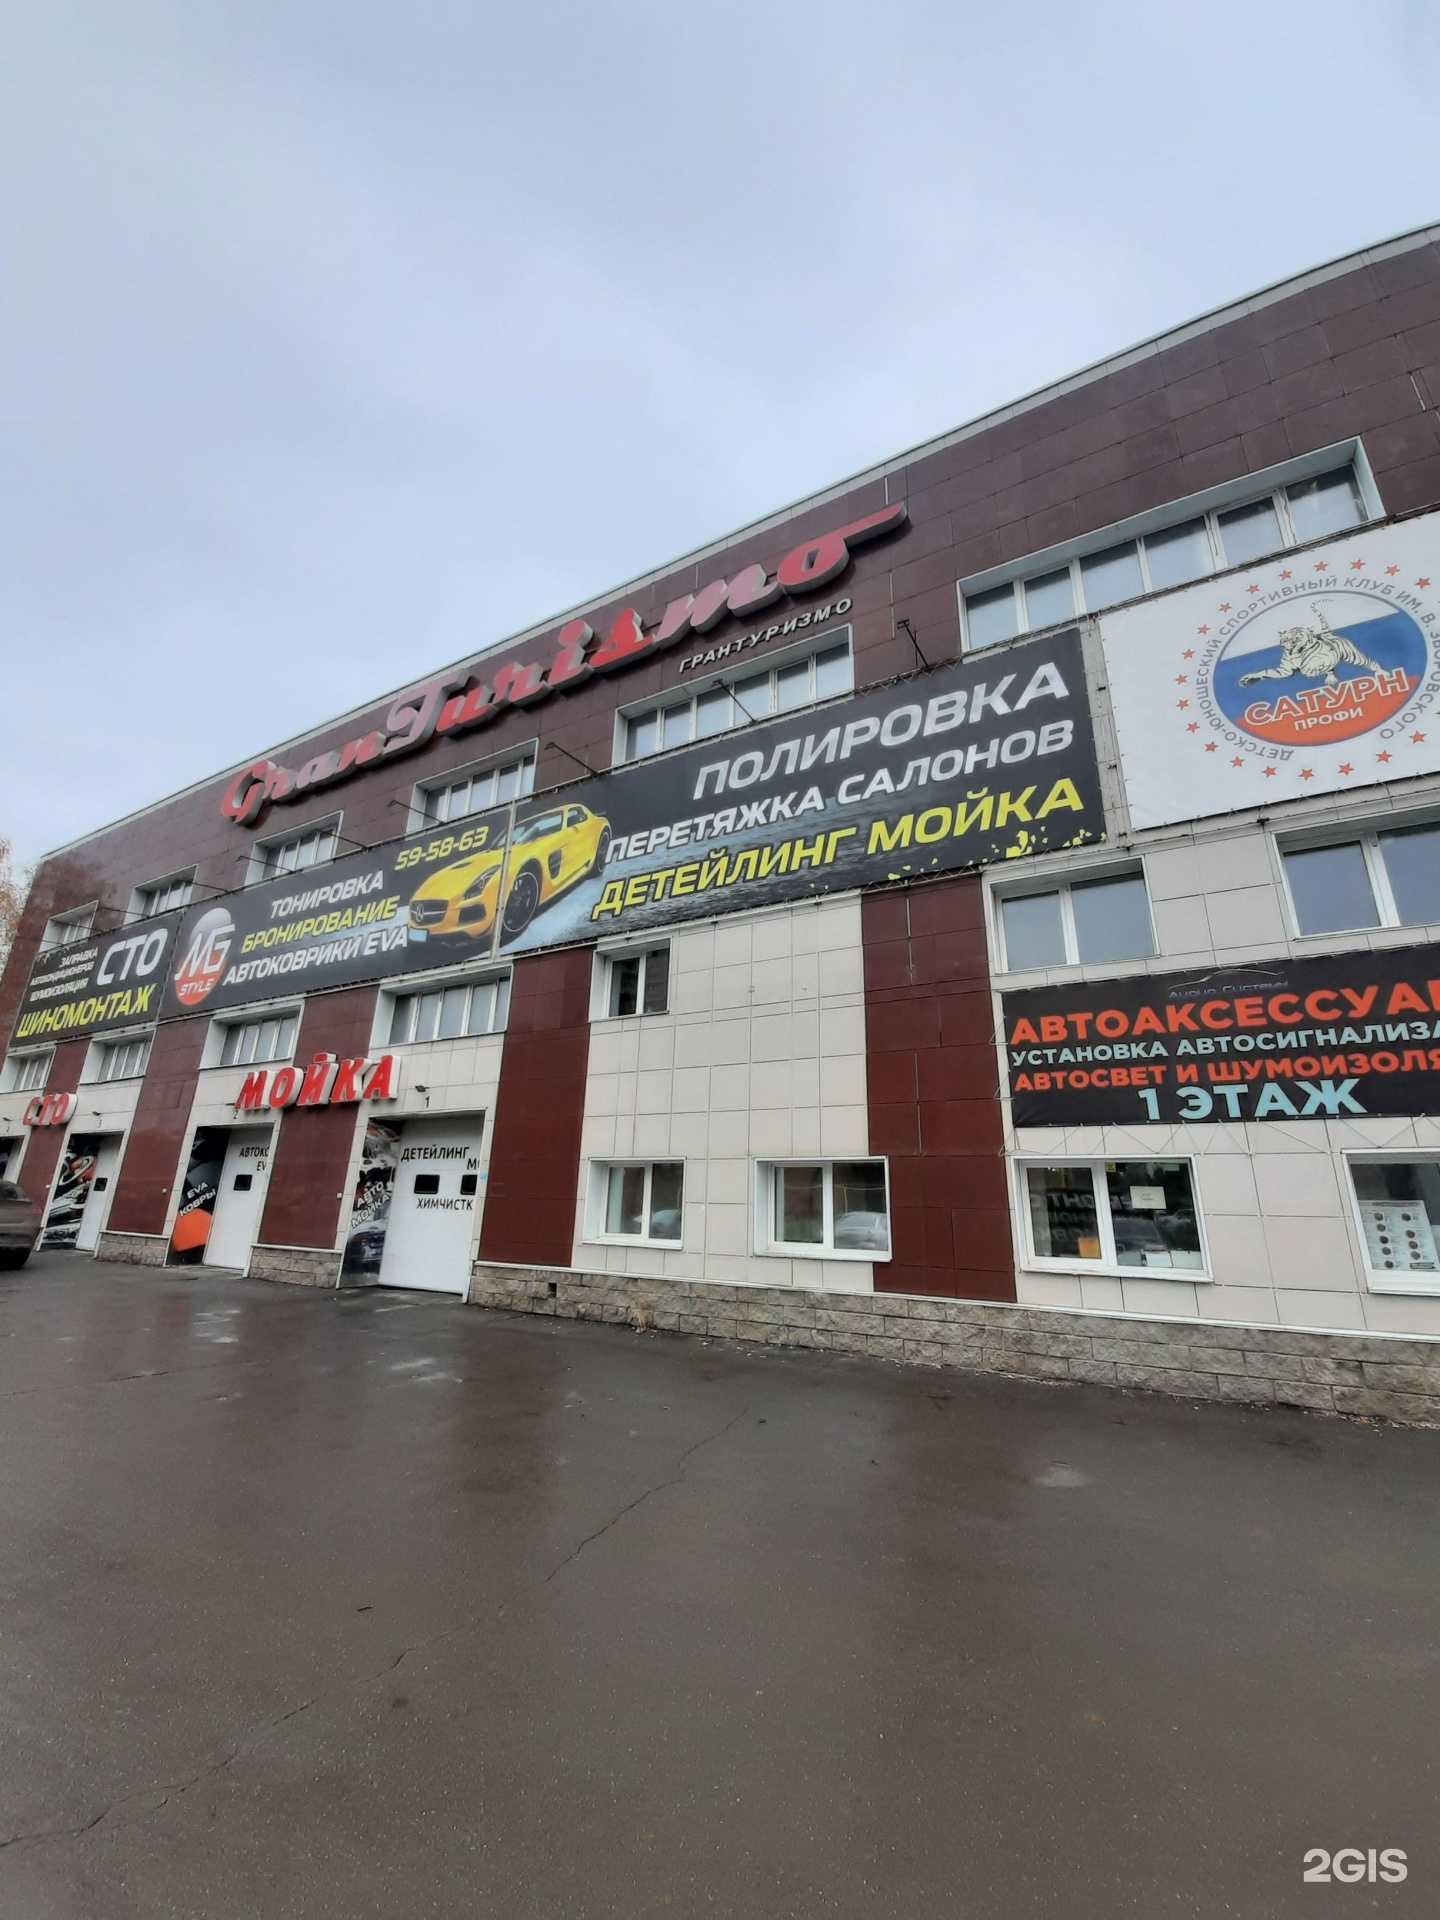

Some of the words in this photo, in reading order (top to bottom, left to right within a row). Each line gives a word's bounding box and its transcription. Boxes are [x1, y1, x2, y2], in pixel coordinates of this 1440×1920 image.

[1219, 575, 1337, 637] СПОРТИВНЫЙ
[1343, 576, 1395, 595] КЛУБ
[678, 597, 853, 674] ГРАНТУРИЗМО
[1244, 667, 1409, 726] САТУРН
[1294, 707, 1363, 731] ПРОФИ
[693, 662, 1069, 800] ПОЛИРОВКА
[605, 792, 825, 864] ПЕРЕТЯЖКА
[837, 719, 1074, 805] САЛОНОВ
[394, 825, 490, 871] 59-58-63
[591, 826, 856, 921] ДЕТЕЙЛИНГ
[867, 778, 1084, 856] МОЙКА
[270, 870, 384, 920] ТОНИРОВКА
[241, 895, 400, 953] БРОНИРОВАНИЕ
[97, 928, 168, 986] СТО
[223, 944, 363, 986] АВТОКОВРИКИ
[365, 928, 409, 952] EVA
[16, 983, 158, 1038] ШИНОМОНТАЖ
[179, 978, 215, 997] STYLE
[1011, 1040, 1168, 1067] УСТАНОВКА
[234, 1053, 400, 1110] МОЙКА
[1014, 1065, 1167, 1092] АВТОСВЕТ
[1177, 1065, 1199, 1085] И
[1137, 1088, 1161, 1120] 1
[1175, 1078, 1368, 1120] ЭТАЖ
[22, 1092, 77, 1126] СТО
[400, 1145, 470, 1163] ДЕТЕЙЛИНГ
[178, 1189, 217, 1217] КОВРЫ
[186, 1182, 208, 1199] EVA
[350, 1190, 393, 1229] МОЙКА
[356, 1181, 385, 1207] АВТО
